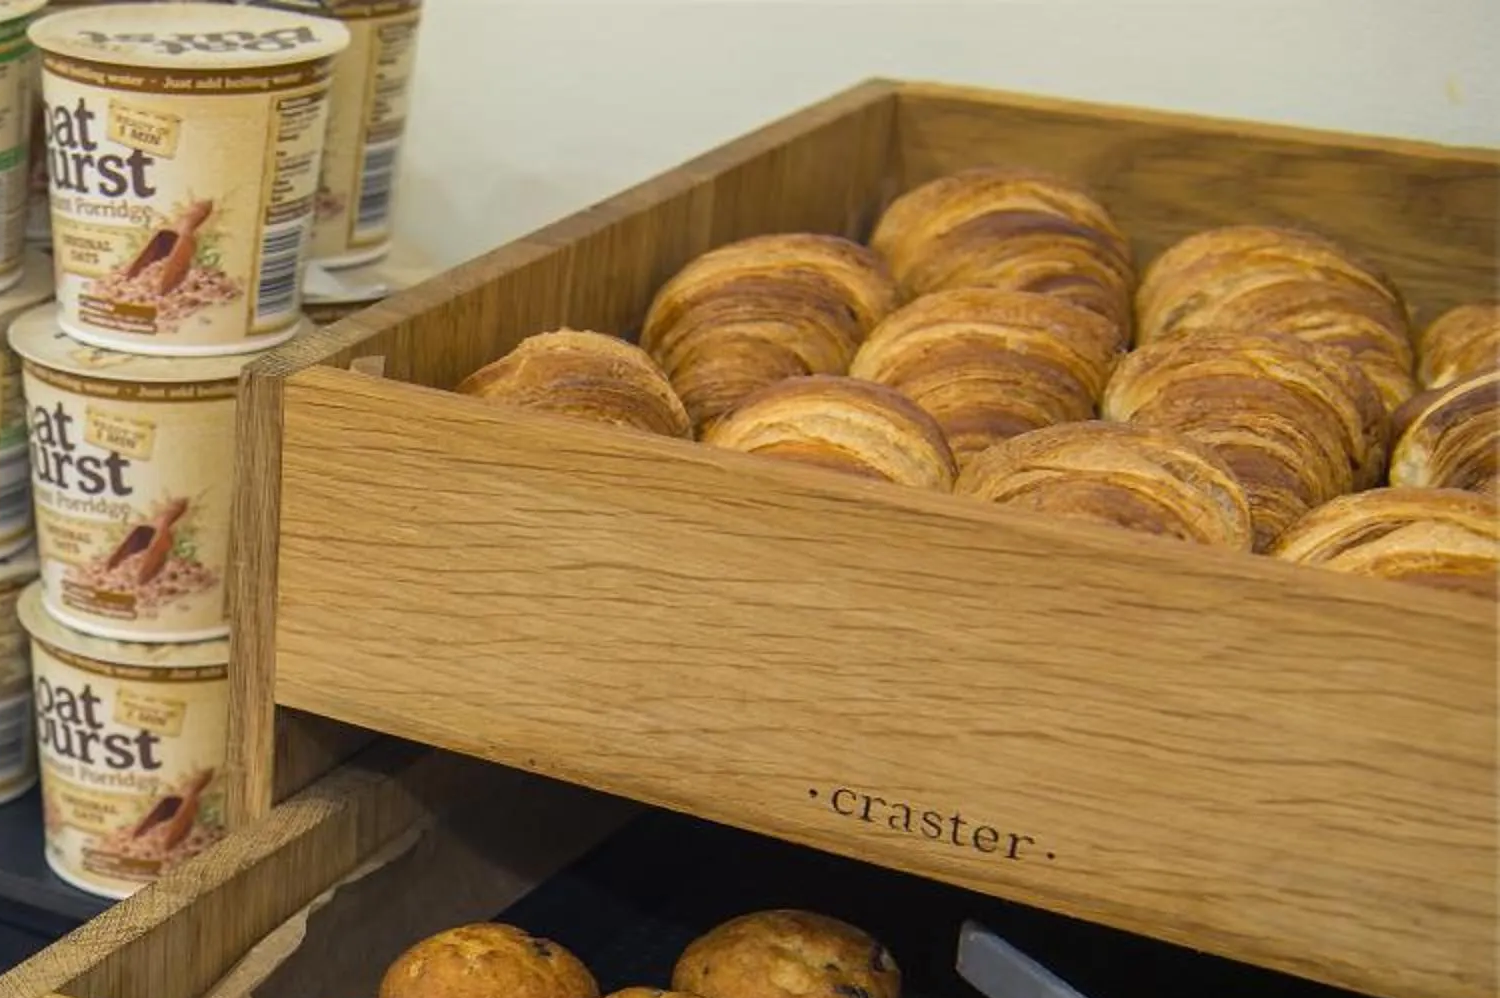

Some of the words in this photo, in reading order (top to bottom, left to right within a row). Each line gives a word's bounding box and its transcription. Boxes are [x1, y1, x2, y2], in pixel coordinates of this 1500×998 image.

[47, 147, 157, 198] urst
[33, 400, 75, 451] at
[32, 442, 133, 496] urst
